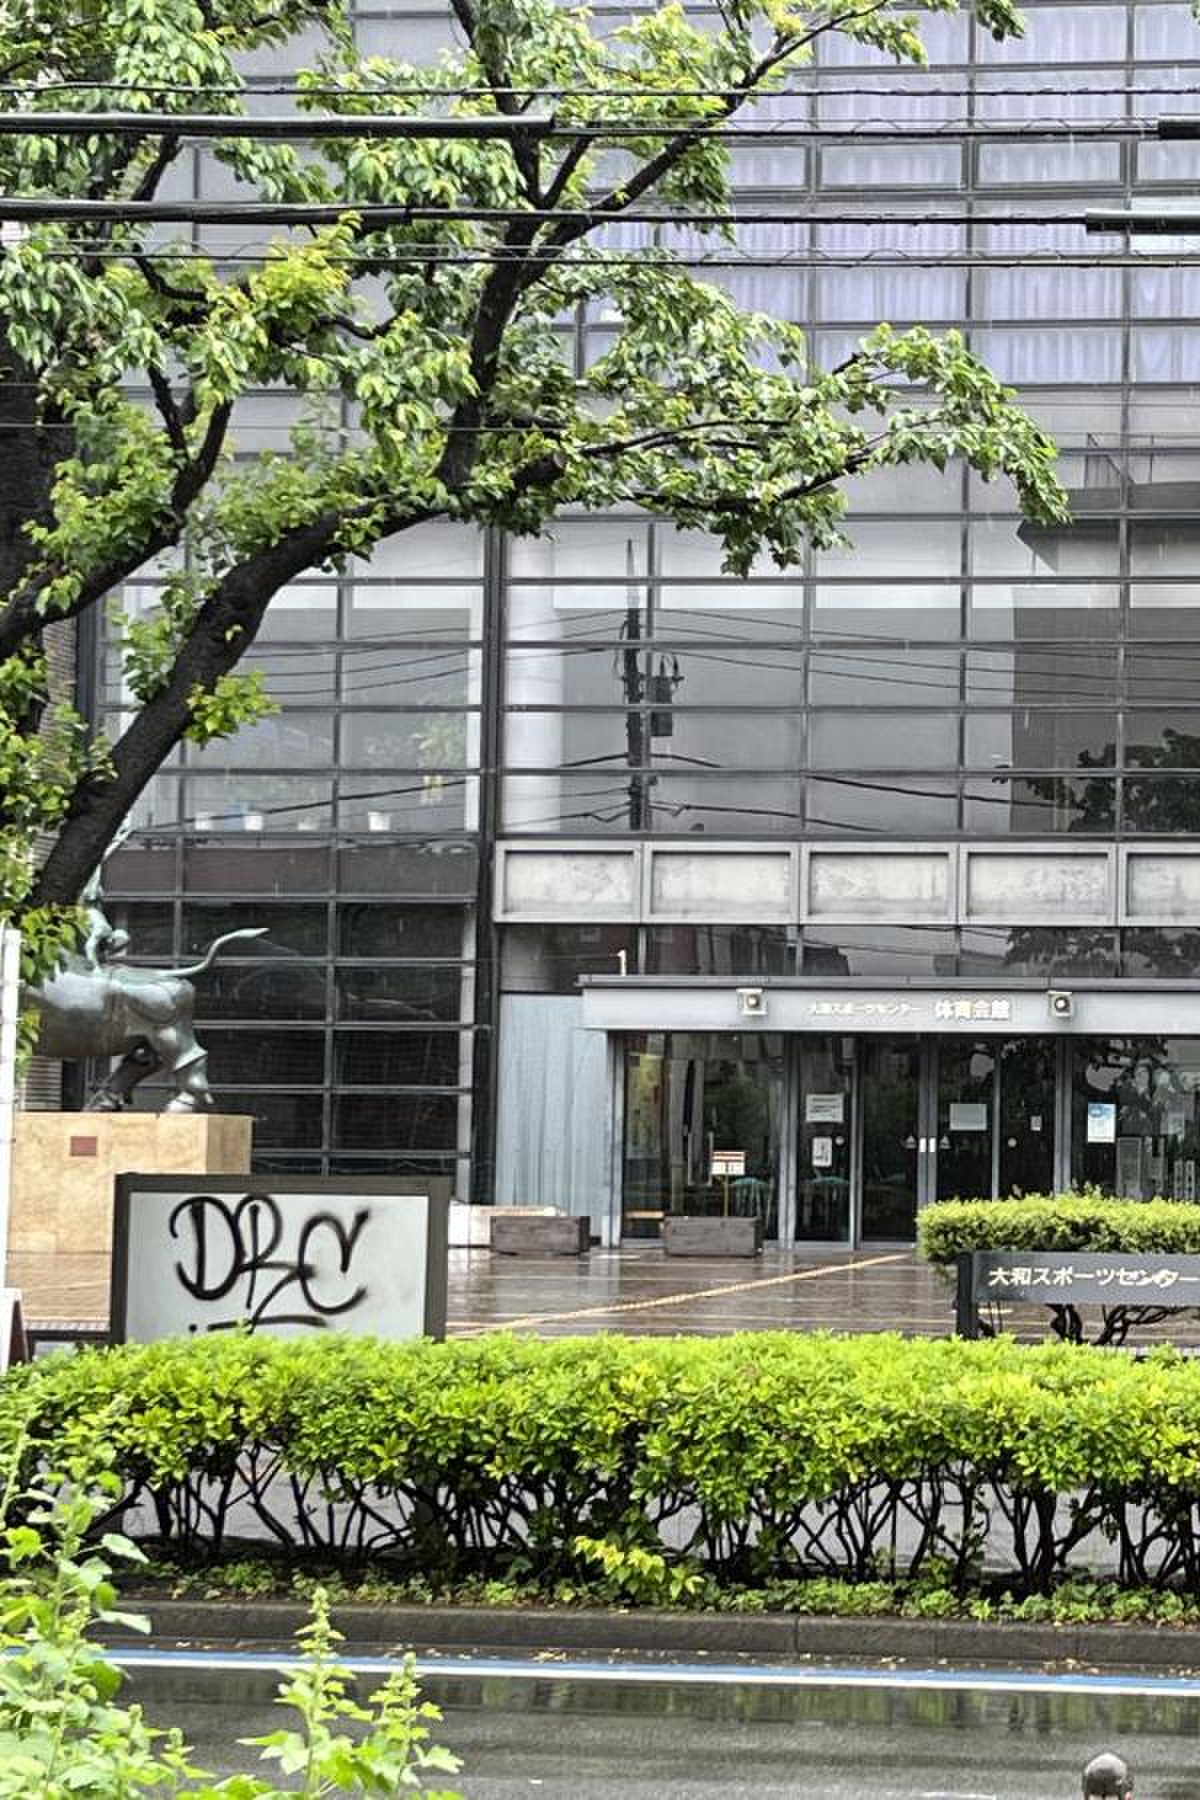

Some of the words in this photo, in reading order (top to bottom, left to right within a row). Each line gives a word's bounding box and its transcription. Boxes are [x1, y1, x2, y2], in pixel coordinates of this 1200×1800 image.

[988, 1266, 1200, 1288] 大和スポーツセンター
